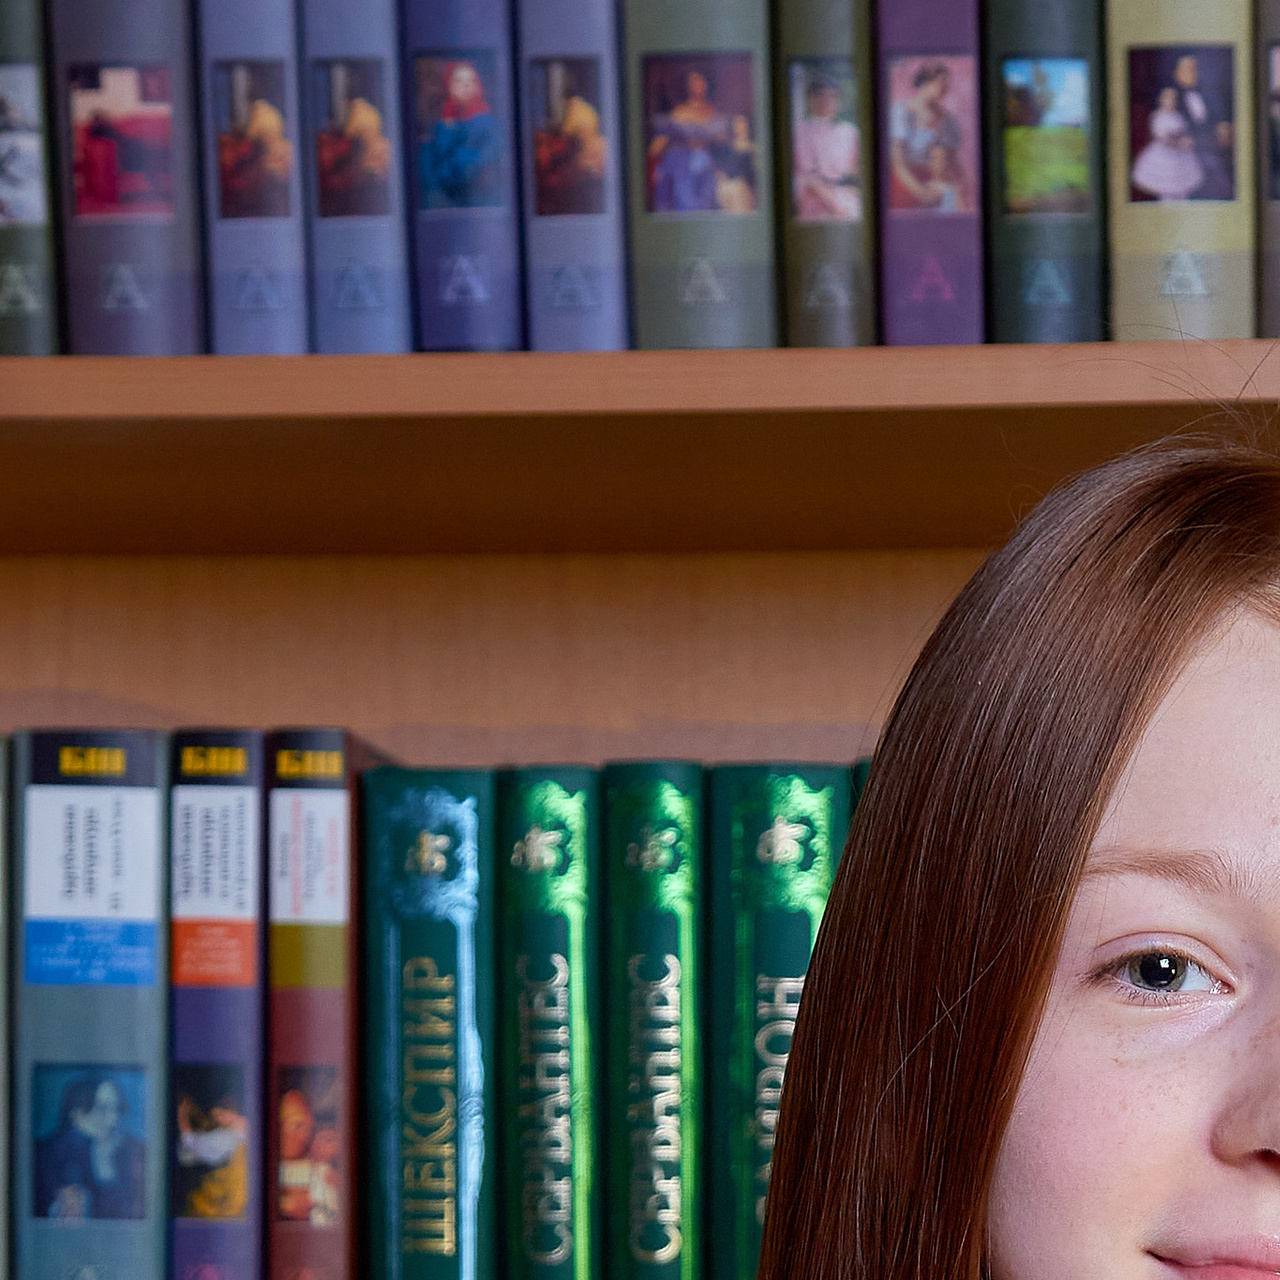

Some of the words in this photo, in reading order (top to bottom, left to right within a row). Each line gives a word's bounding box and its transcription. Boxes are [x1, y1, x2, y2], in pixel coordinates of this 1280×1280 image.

[402, 956, 457, 1257] ШЕКСПИР
[516, 953, 572, 1265] СЕРВАНТЕС
[627, 953, 682, 1265] СЕРВАНТЕС
